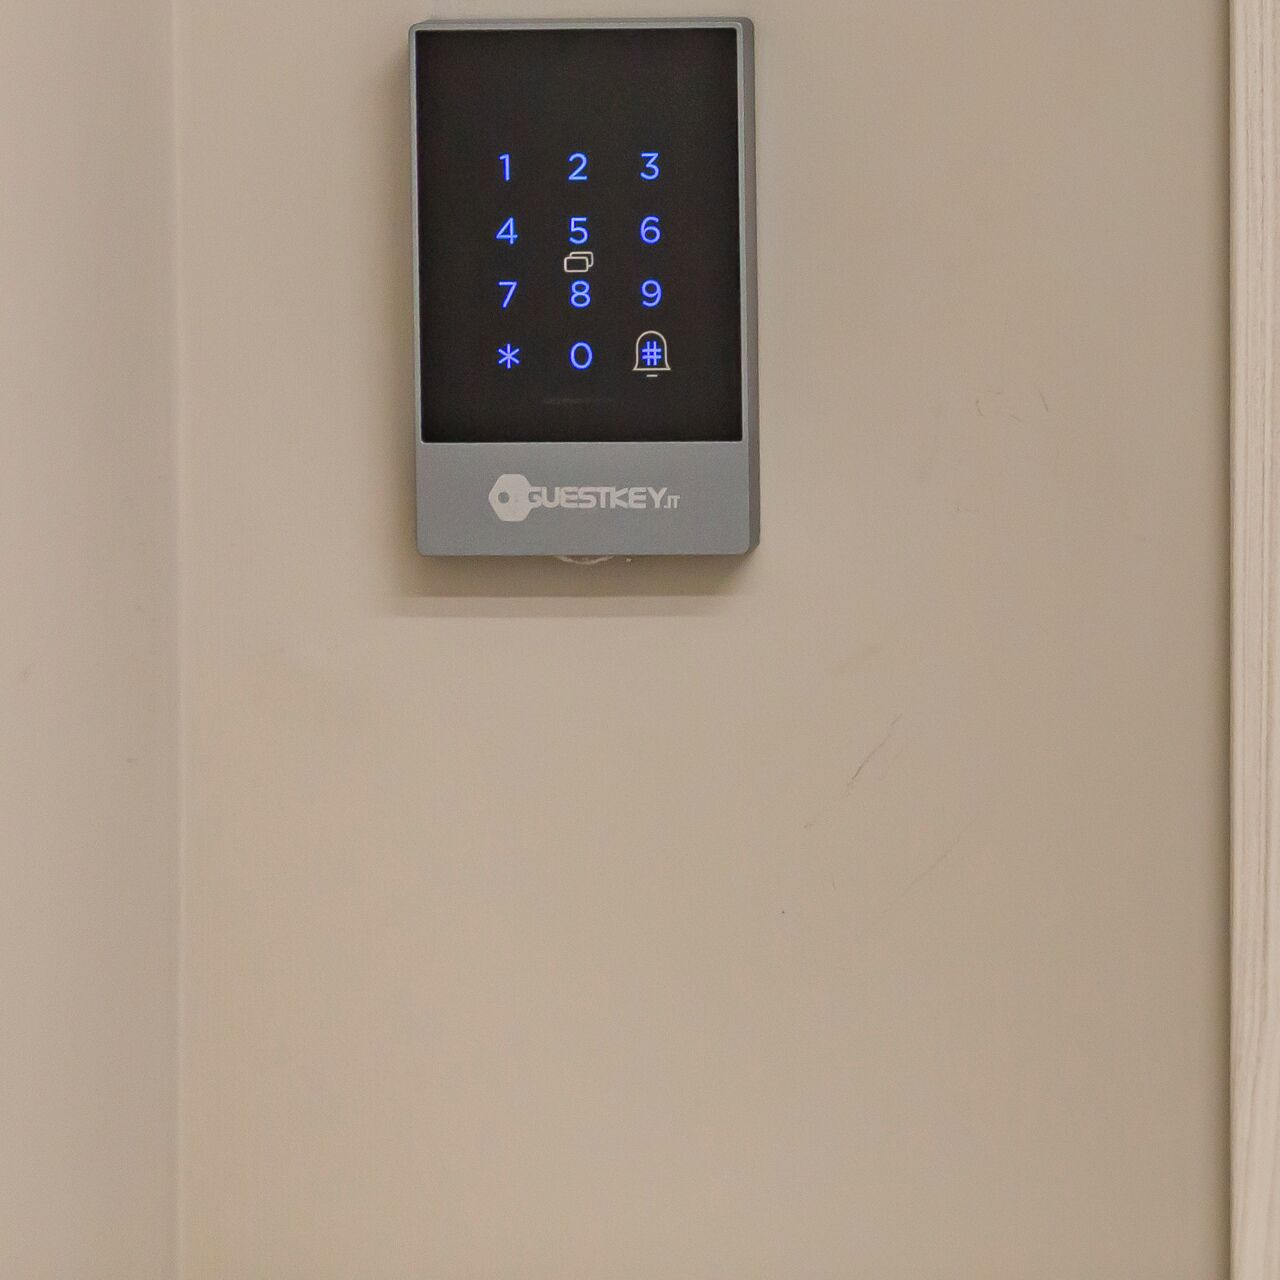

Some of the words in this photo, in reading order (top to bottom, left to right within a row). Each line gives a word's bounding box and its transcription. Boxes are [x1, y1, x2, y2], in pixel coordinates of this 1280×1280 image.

[497, 152, 511, 182] 1
[567, 151, 589, 182] 2
[639, 151, 661, 181] 3
[495, 215, 519, 246] 4
[567, 215, 591, 246] 5
[639, 214, 662, 246] 6
[497, 279, 519, 309] 7
[568, 278, 592, 309] 8
[639, 278, 663, 308] 9
[568, 340, 594, 371] 0
